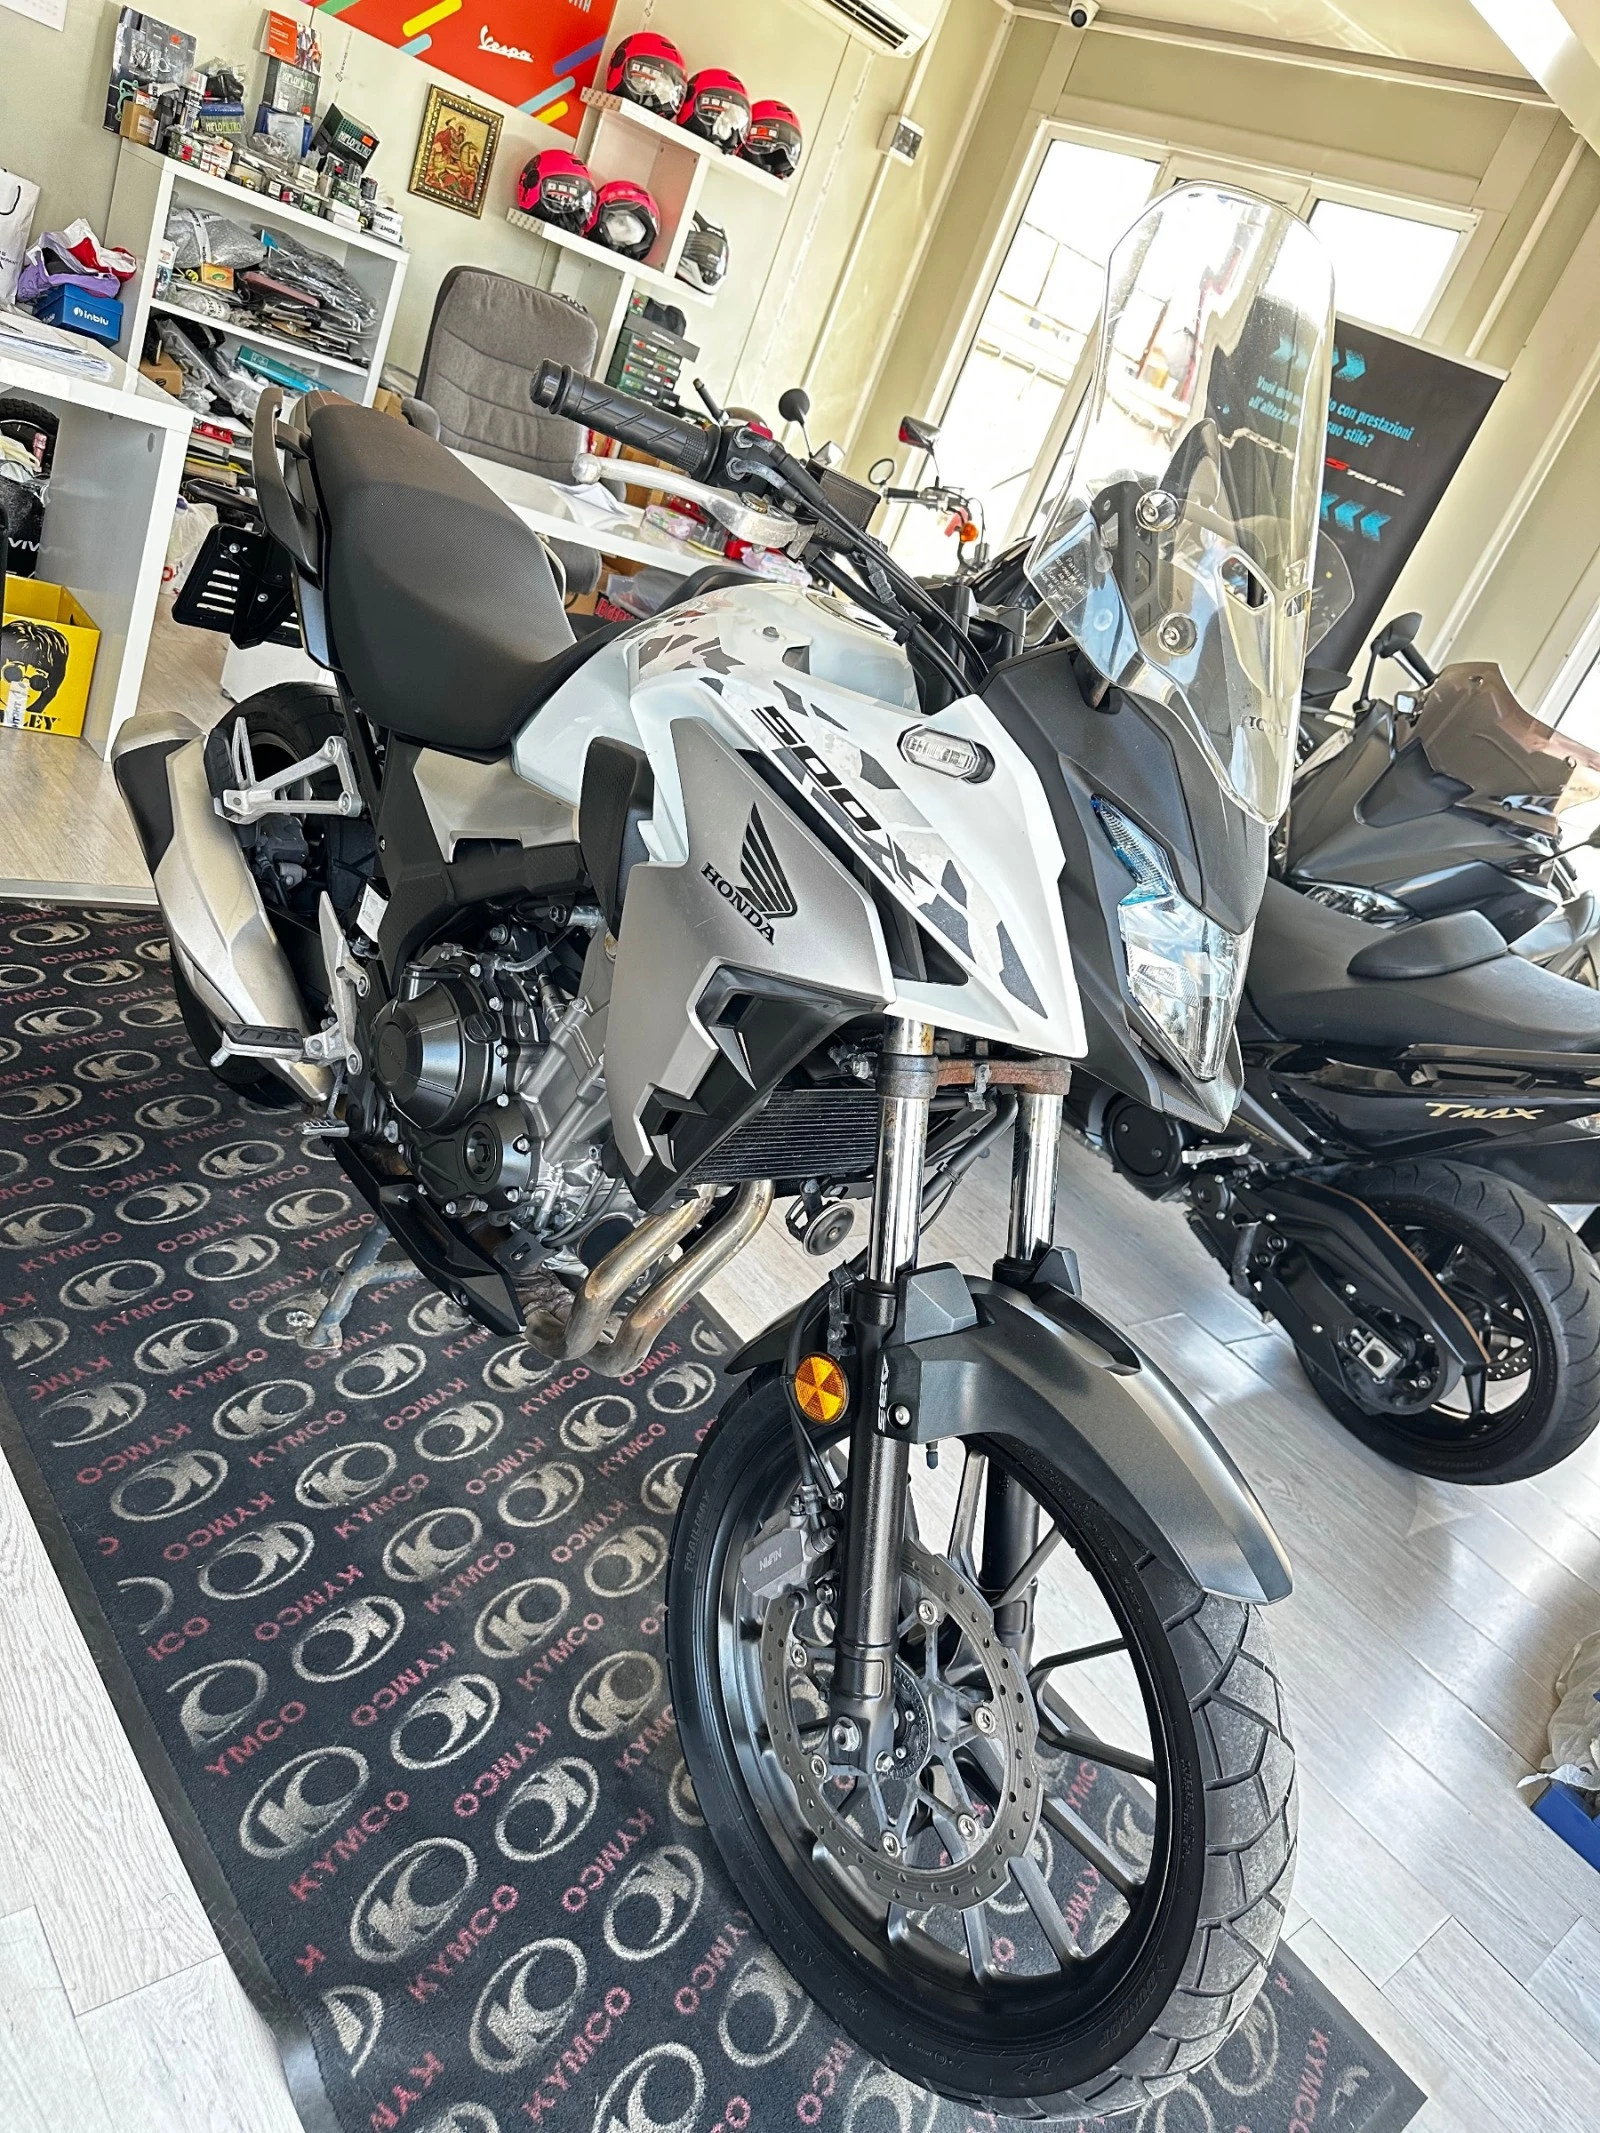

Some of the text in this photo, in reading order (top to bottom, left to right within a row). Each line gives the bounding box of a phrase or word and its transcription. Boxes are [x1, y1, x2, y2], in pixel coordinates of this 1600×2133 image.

[478, 25, 534, 63] Vespa
[205, 121, 242, 133] HIFLOFILTRO
[339, 131, 373, 158] HIFLOFILTRO
[83, 309, 109, 327] inblu
[1257, 375, 1276, 395] Vuoi
[1337, 402, 1356, 419] con
[1356, 410, 1415, 442] prestazioni
[1326, 421, 1343, 437] suo
[1343, 428, 1375, 448] stile?
[751, 705, 935, 895] 500X
[701, 862, 776, 946] HONDA
[107, 923, 164, 937] KYMC
[42, 947, 119, 964] KYMCO
[97, 985, 175, 1005] KYMCO
[41, 1029, 125, 1055] KYMCO
[0, 1066, 56, 1087] KYM
[101, 1074, 184, 1100] KYMCO
[24, 1113, 117, 1144] KYMCO
[163, 1118, 246, 1148] KYMCO
[1424, 1103, 1545, 1121] TMAX
[0, 1178, 54, 1201] MCO
[88, 1162, 181, 1197] KYMCO
[228, 1165, 310, 1199] KYMCO
[20, 1233, 123, 1273] KYMCO
[157, 1216, 249, 1254] KYMCO
[290, 1213, 376, 1250] KYMCO
[93, 1289, 195, 1336] KYMCO
[228, 1268, 317, 1311] KYMCO
[368, 1280, 416, 1304] KYM
[304, 1320, 393, 1369] KYMO
[169, 1349, 268, 1400] KYMCO
[519, 1367, 591, 1416] KYMCO
[384, 1380, 468, 1430] KYMCO
[77, 1424, 191, 1484] KYMCO
[250, 1410, 346, 1468] KYMCO
[598, 1424, 667, 1477] KYMCO
[466, 1437, 546, 1494] KYMCO
[164, 1491, 275, 1561] KYMCO
[335, 1474, 429, 1540] KYMCO
[553, 1500, 628, 1562] KYMCO
[425, 1542, 516, 1613] KYMCO
[255, 1565, 365, 1641] KYMCO
[518, 1613, 604, 1689] KYMCO
[351, 1643, 454, 1726] KYMCO
[615, 1702, 673, 1776] KYMC
[453, 1721, 551, 1818] KYMCO
[289, 1790, 411, 1901] KYMCO
[561, 1809, 653, 1913] KYMCO
[409, 1885, 519, 2001] KYMCO
[523, 1987, 632, 2122] KYMCO
